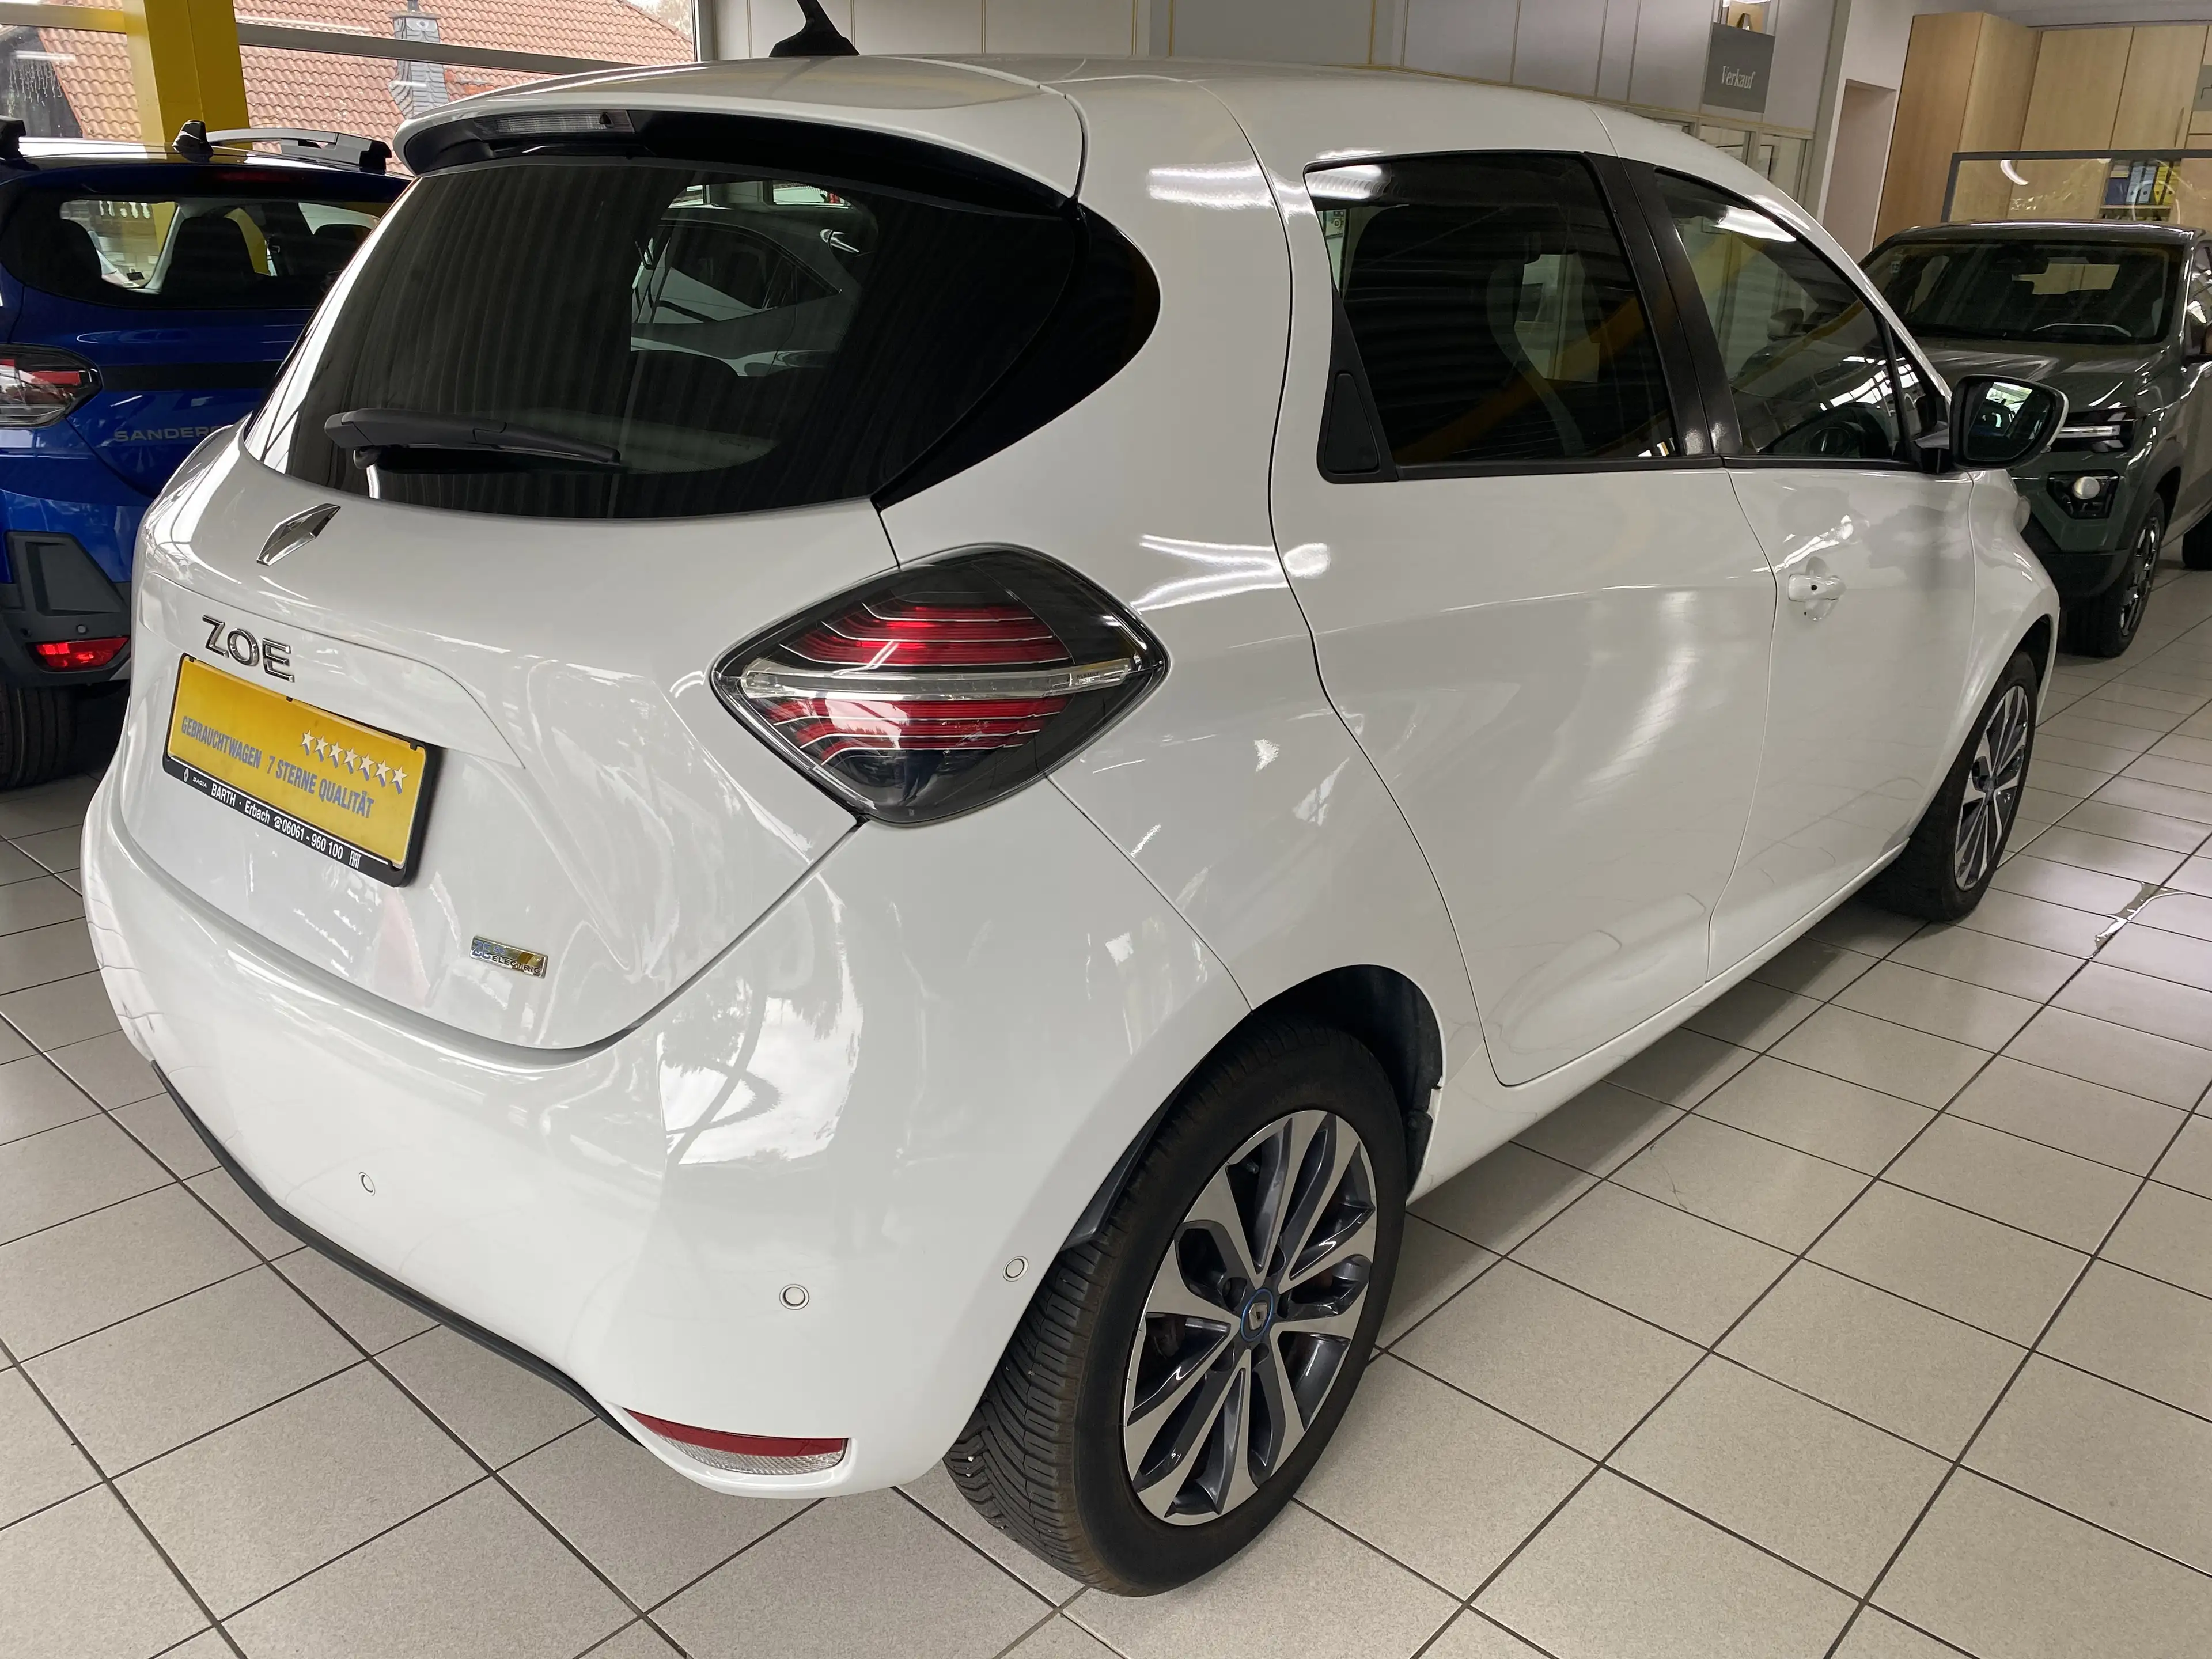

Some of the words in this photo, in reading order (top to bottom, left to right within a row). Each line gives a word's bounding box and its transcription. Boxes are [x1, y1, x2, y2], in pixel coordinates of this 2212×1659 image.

[1721, 65, 1756, 89] Verkauf
[202, 615, 294, 683] ZOE
[181, 715, 262, 769] GEBRAUCHTWAGEN
[267, 755, 275, 774] 7
[275, 759, 317, 794] STERNE
[319, 778, 374, 818] QUALITÄT
[192, 777, 207, 789] DACIA
[211, 783, 236, 806] BARTH
[244, 800, 270, 824] Erbach
[282, 819, 305, 841] 06061
[311, 833, 327, 851] 960
[328, 841, 343, 860] 100
[349, 850, 362, 869] FIAT
[491, 955, 542, 974] ELECTRIC
